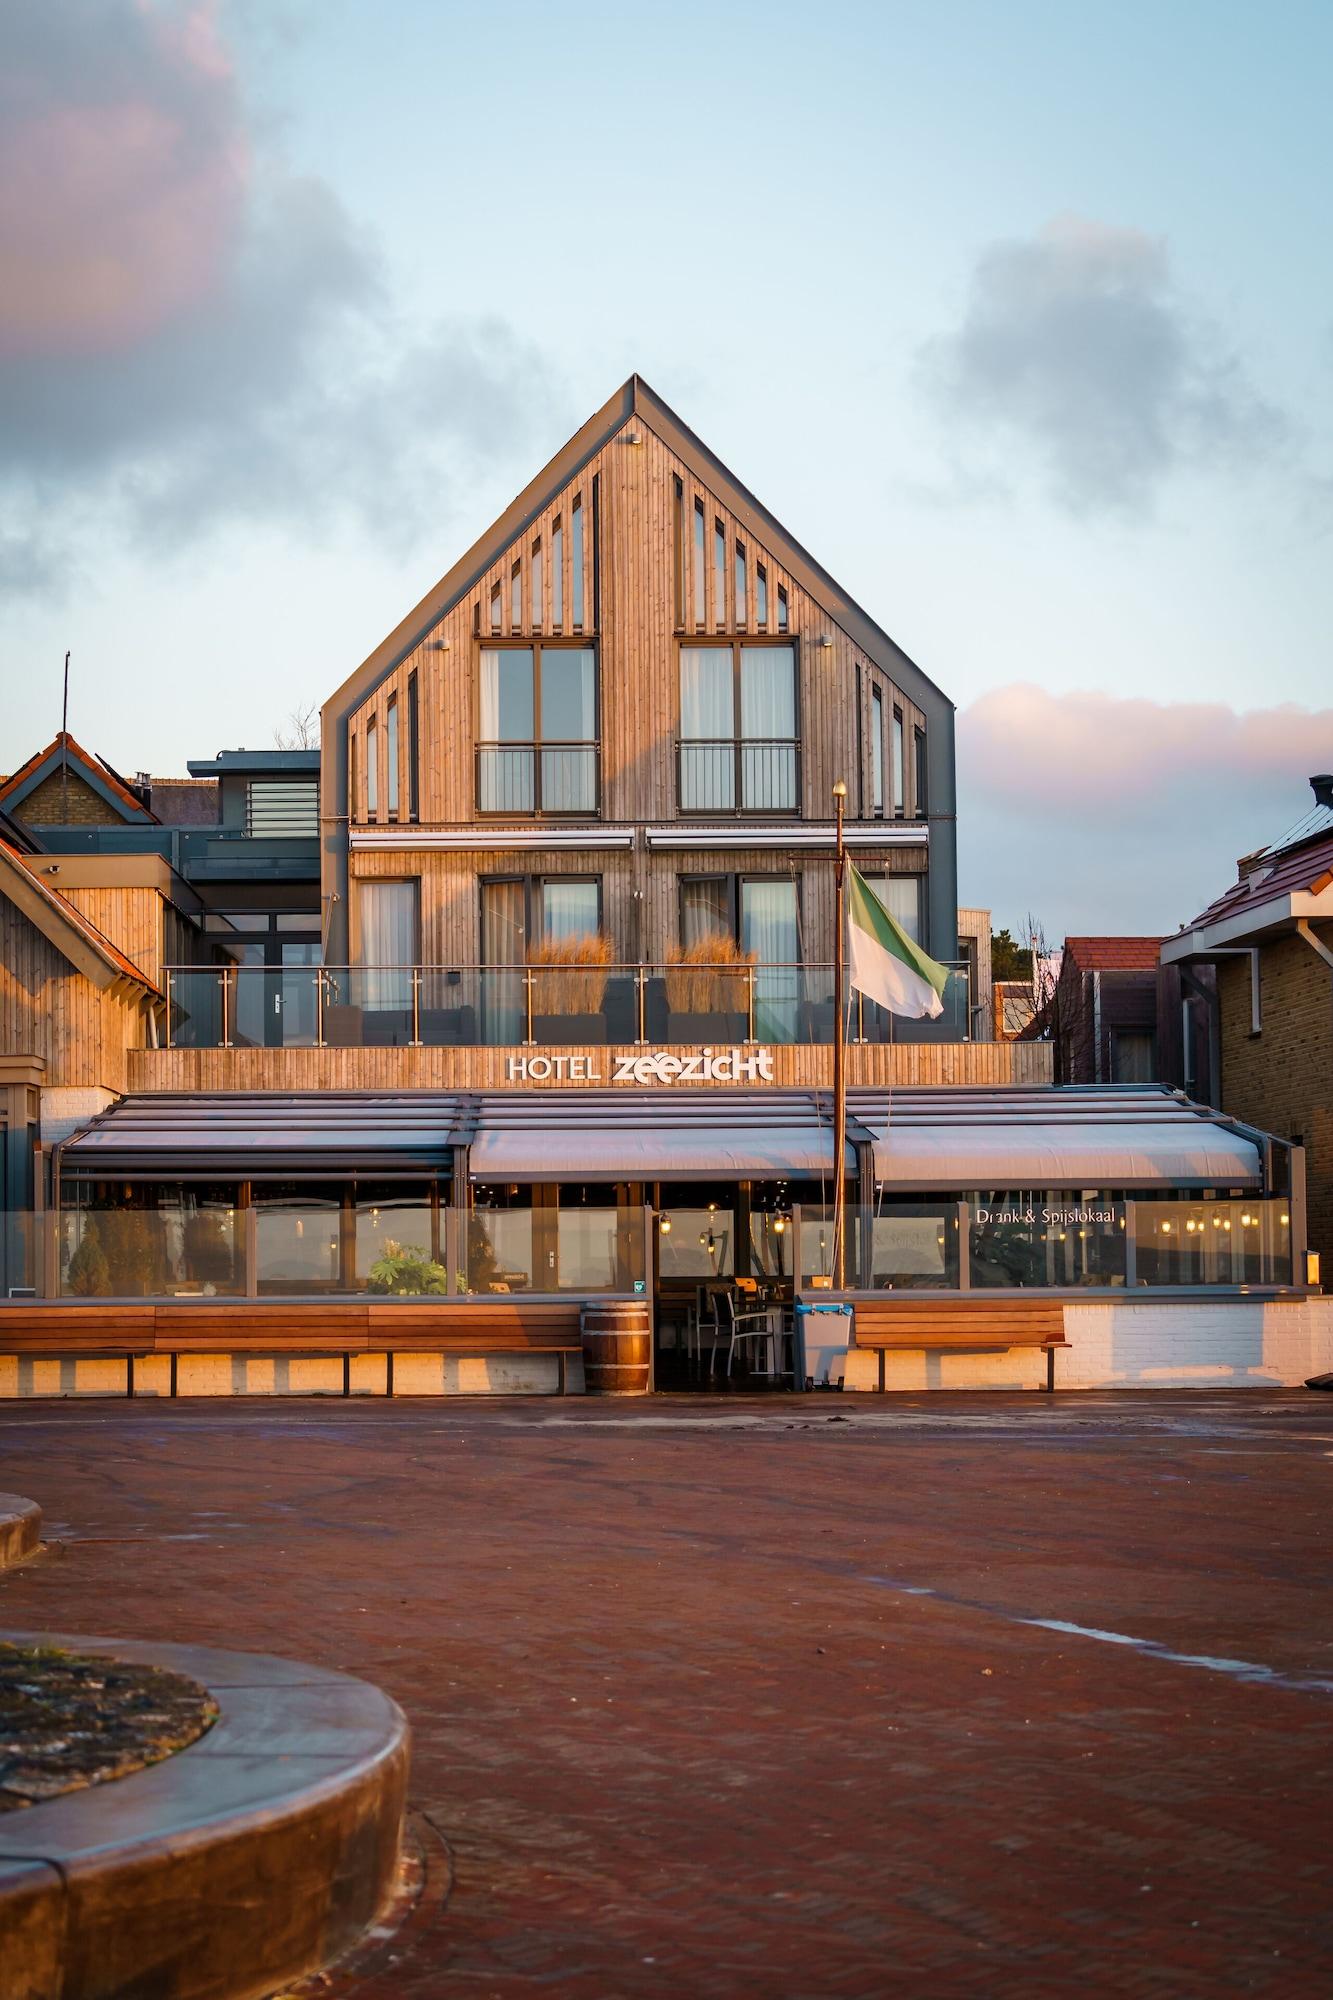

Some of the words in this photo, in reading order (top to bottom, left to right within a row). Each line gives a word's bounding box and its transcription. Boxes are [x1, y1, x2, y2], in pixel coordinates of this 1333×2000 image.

[509, 1057, 601, 1080] HOTEL
[976, 1209, 1020, 1224] Drank
[1025, 1209, 1036, 1223] &
[1041, 1208, 1115, 1226] Spijslokaal
